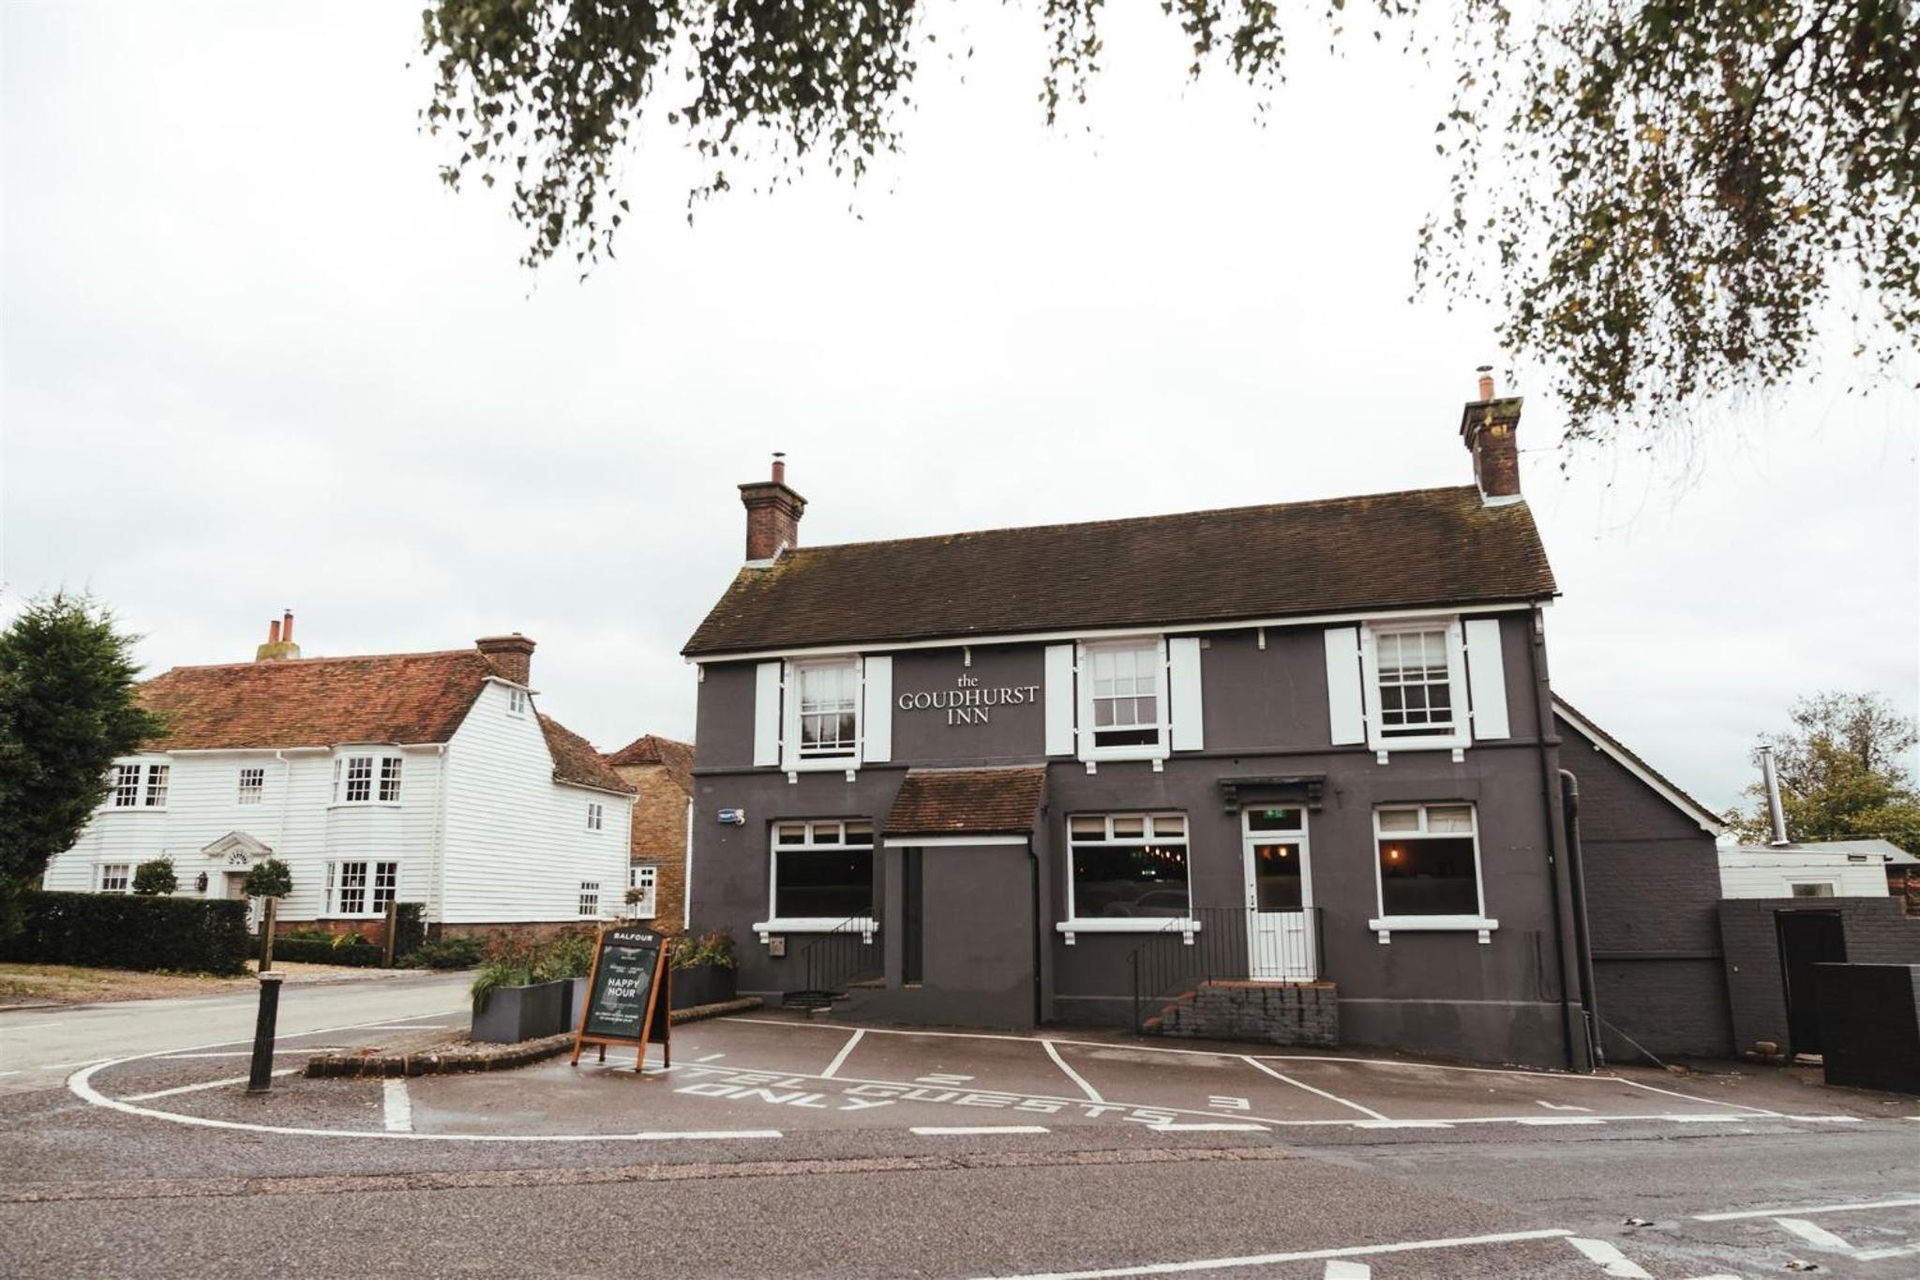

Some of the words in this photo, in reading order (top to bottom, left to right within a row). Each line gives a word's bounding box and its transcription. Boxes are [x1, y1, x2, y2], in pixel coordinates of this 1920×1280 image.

[958, 673, 979, 688] the
[899, 685, 1040, 710] GOUDHURST
[947, 707, 990, 725] INN
[614, 932, 653, 941] BALFOUR
[608, 979, 640, 988] HAPPY
[608, 987, 636, 998] HOUR
[673, 1083, 897, 1111] ONLY
[842, 1083, 1178, 1125] GUESTS
[1208, 1095, 1251, 1111] 3
